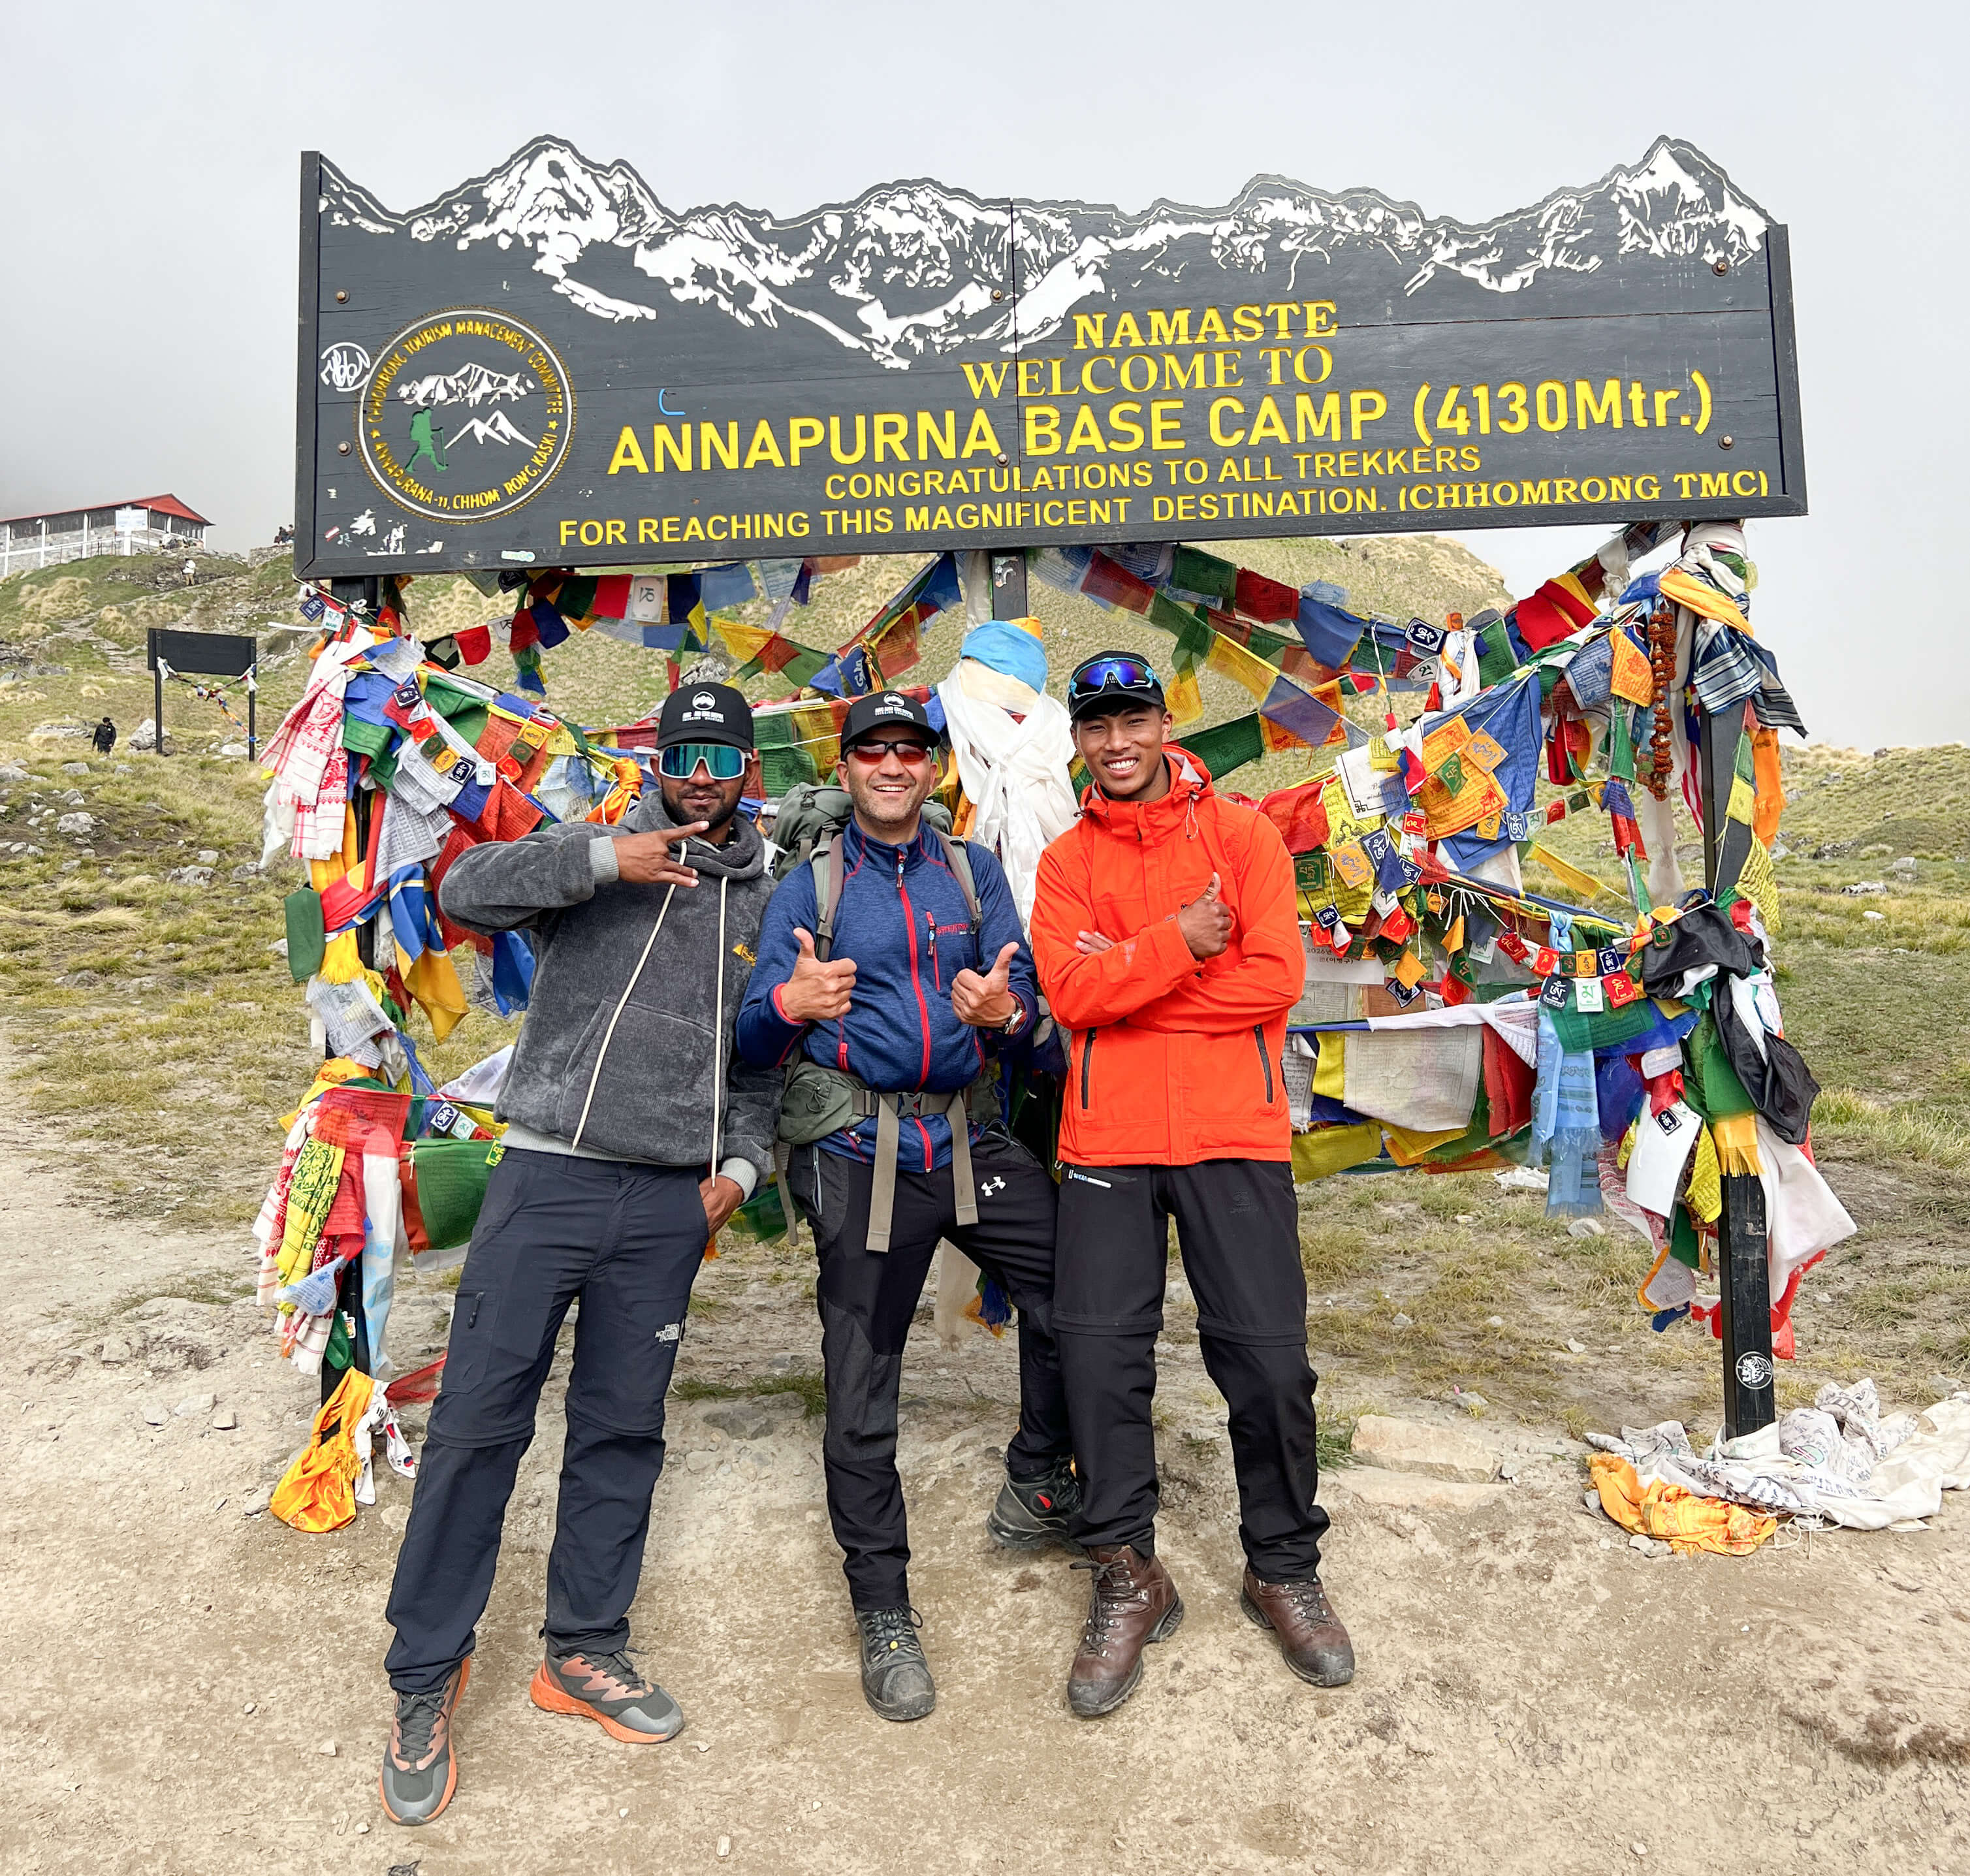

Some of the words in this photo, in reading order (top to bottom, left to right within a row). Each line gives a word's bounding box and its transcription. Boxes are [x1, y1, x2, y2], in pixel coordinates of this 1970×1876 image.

[402, 321, 453, 355] TOURISM
[1073, 300, 1339, 351] NAMASTE
[961, 349, 1244, 400] WELCOME
[1258, 344, 1333, 387] TO
[607, 406, 1002, 475] ANNAPURNA
[1025, 398, 1186, 456] BASE
[1209, 389, 1388, 447] CAMP
[1414, 369, 1713, 447] (4130Mtr.)
[453, 488, 501, 510] CHHOM
[531, 432, 558, 468] KASKI
[825, 460, 1152, 500] CONGRATULATIONS
[1162, 458, 1209, 486] TO
[1217, 452, 1282, 483] ALL
[1292, 445, 1482, 479] TREKKERS
[560, 517, 628, 547] FOR
[638, 505, 810, 544] REACHING
[819, 506, 894, 536] THIS
[904, 496, 1132, 532] MAGNIFICENT
[1152, 484, 1388, 522] DESTINATION.
[1398, 473, 1662, 513] (CHHOMRONG
[1673, 469, 1769, 500] TMC)
